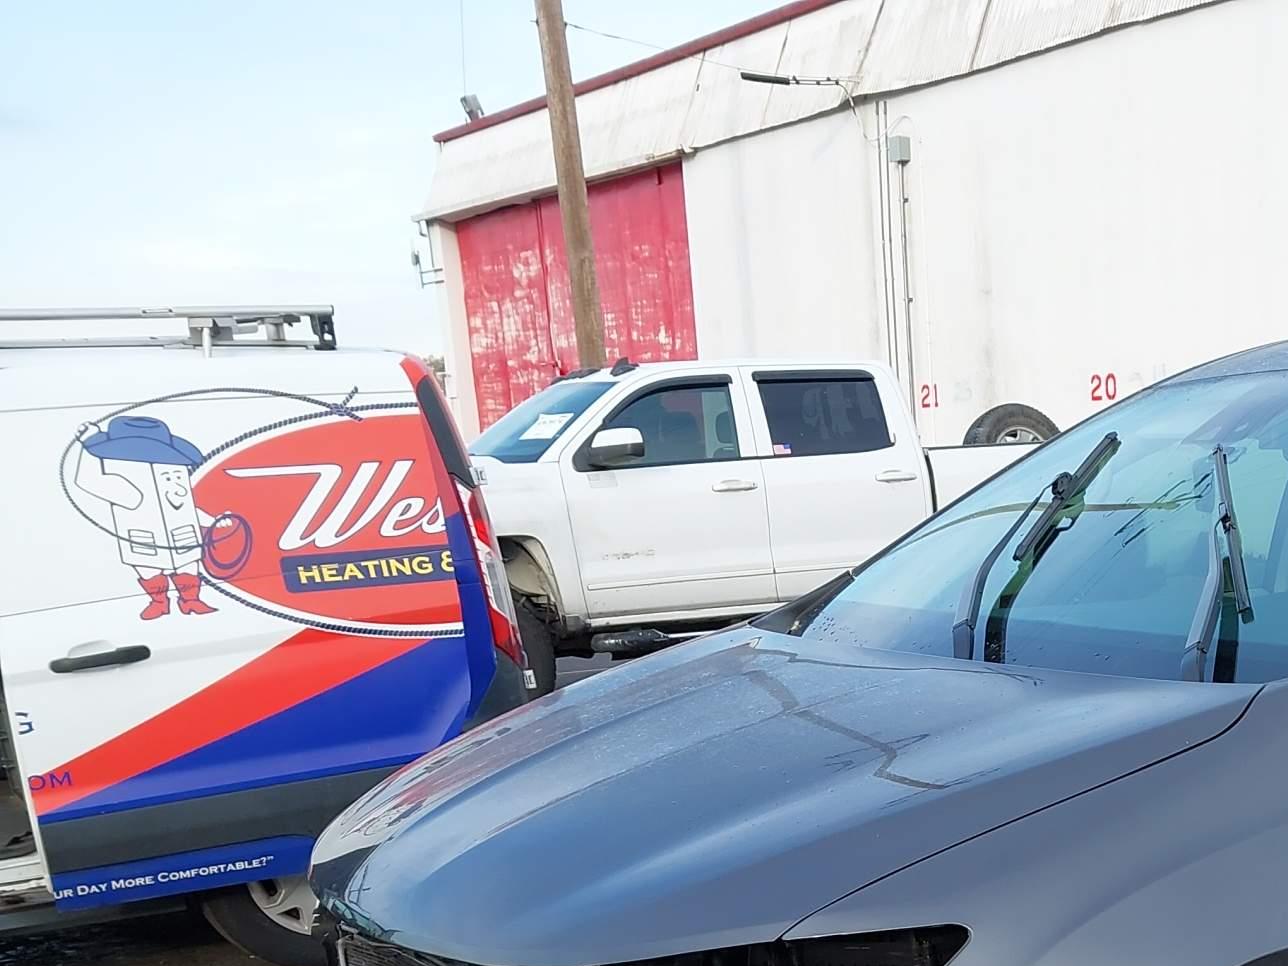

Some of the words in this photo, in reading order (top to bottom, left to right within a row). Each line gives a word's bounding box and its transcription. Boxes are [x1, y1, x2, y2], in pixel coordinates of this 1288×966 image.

[920, 383, 939, 409] 21
[1090, 372, 1117, 401] 20
[297, 556, 434, 585] HEATING
[76, 882, 107, 896] DAY
[111, 876, 155, 890] MORE
